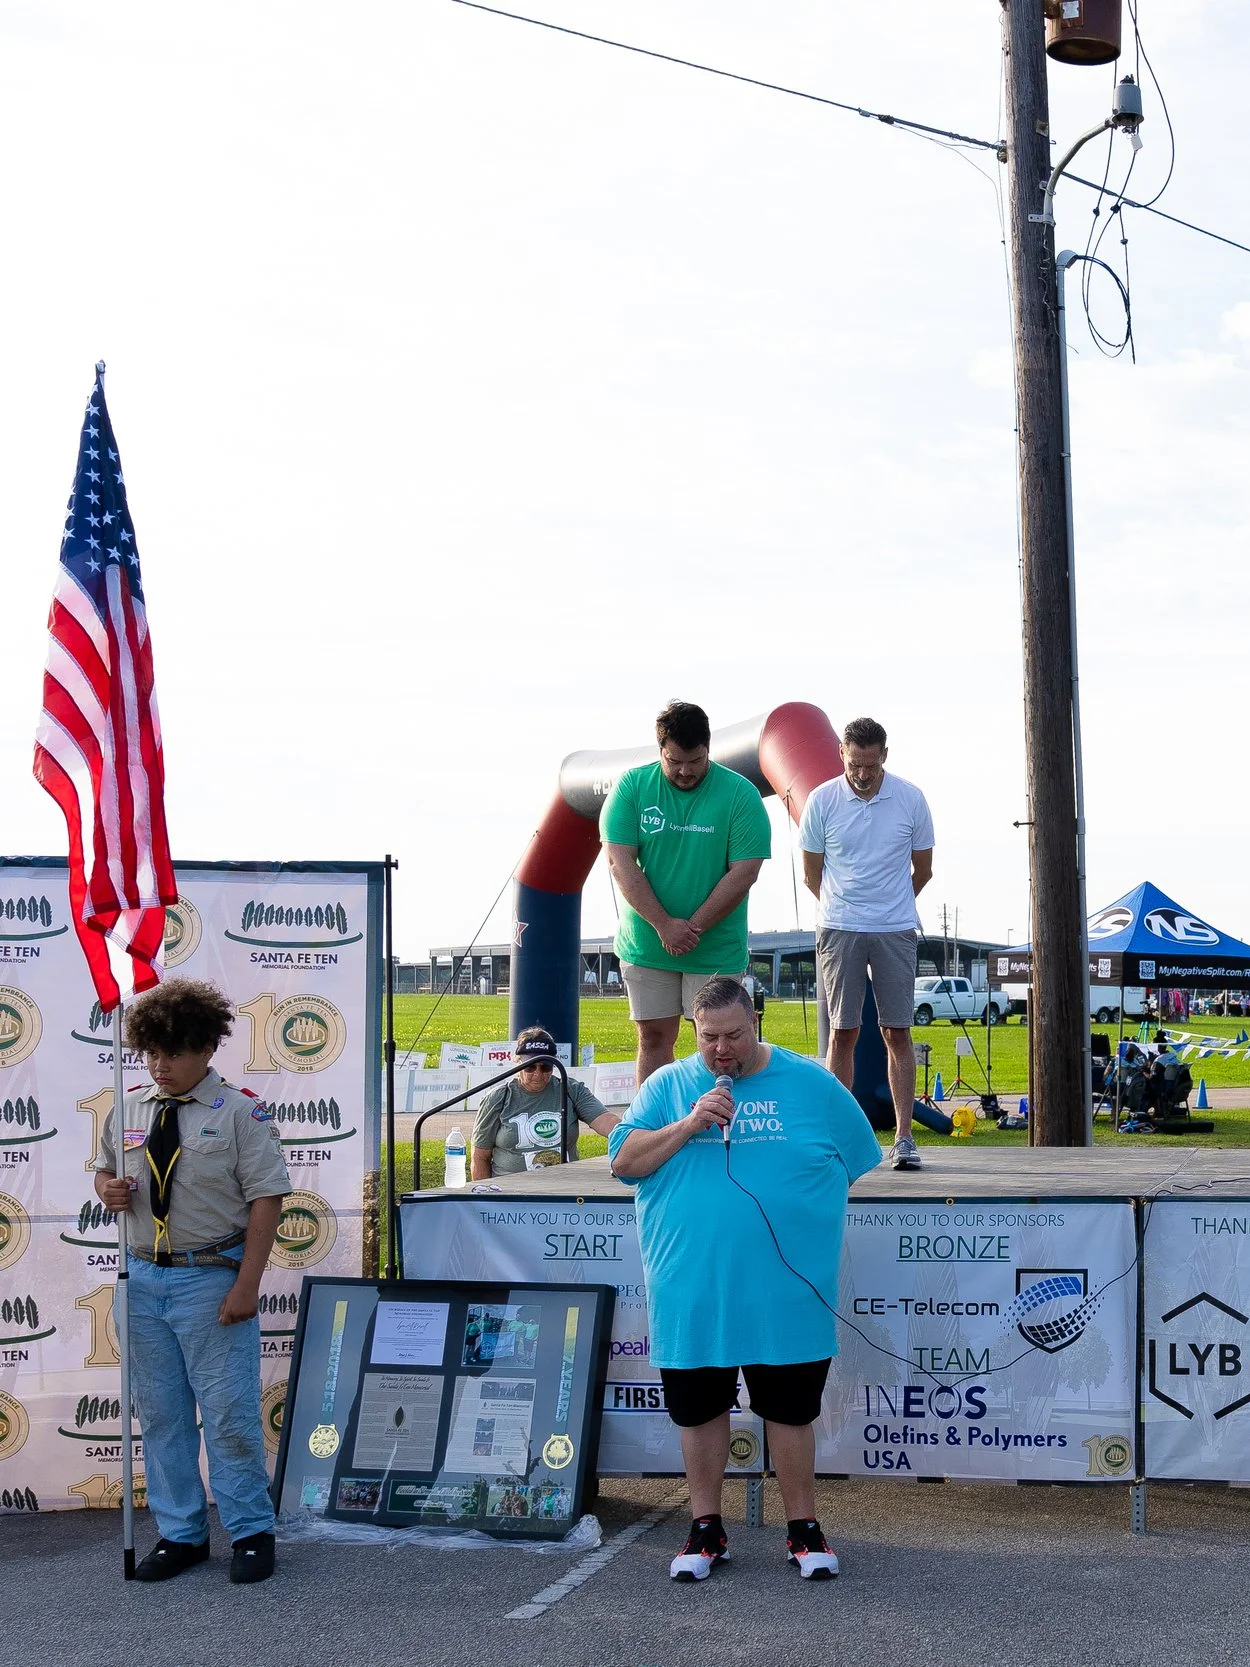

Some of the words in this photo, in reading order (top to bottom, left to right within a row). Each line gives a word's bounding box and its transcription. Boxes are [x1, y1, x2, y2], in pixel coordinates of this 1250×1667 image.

[643, 814, 661, 826] LYB
[14, 946, 40, 958] TEN
[250, 952, 294, 964] SANTA
[297, 953, 311, 964] FE
[314, 953, 338, 965] TEN
[273, 1005, 285, 1017] RUN
[293, 996, 339, 1017] REMEMBRANCE
[287, 1053, 325, 1063] MEMORIAL
[743, 1100, 779, 1116] ONE
[736, 1118, 784, 1134] TWO:
[3, 1151, 30, 1163] TEN
[290, 1150, 304, 1161] FE
[307, 1150, 332, 1161] TEN
[480, 1211, 527, 1225] THANK
[530, 1212, 558, 1225] YOU
[563, 1212, 580, 1226] TO
[584, 1213, 614, 1226] OUR
[846, 1213, 894, 1227] THANK
[897, 1213, 927, 1227] YOU
[931, 1213, 951, 1227] TO
[953, 1213, 985, 1228] OUR
[988, 1213, 1066, 1228] SPONSORS
[544, 1233, 623, 1258] START
[899, 1235, 1011, 1260] BRONZE
[87, 1254, 120, 1266] SANT
[853, 1298, 1000, 1316] CE-Telecom
[2, 1350, 29, 1361] TEN
[913, 1347, 990, 1371] TEAM
[1168, 1342, 1243, 1377] LYB
[863, 1384, 988, 1420] INEOS
[863, 1423, 939, 1445] Olefins
[945, 1425, 962, 1446] &
[967, 1426, 1068, 1451] Polymers
[863, 1450, 912, 1470] USA
